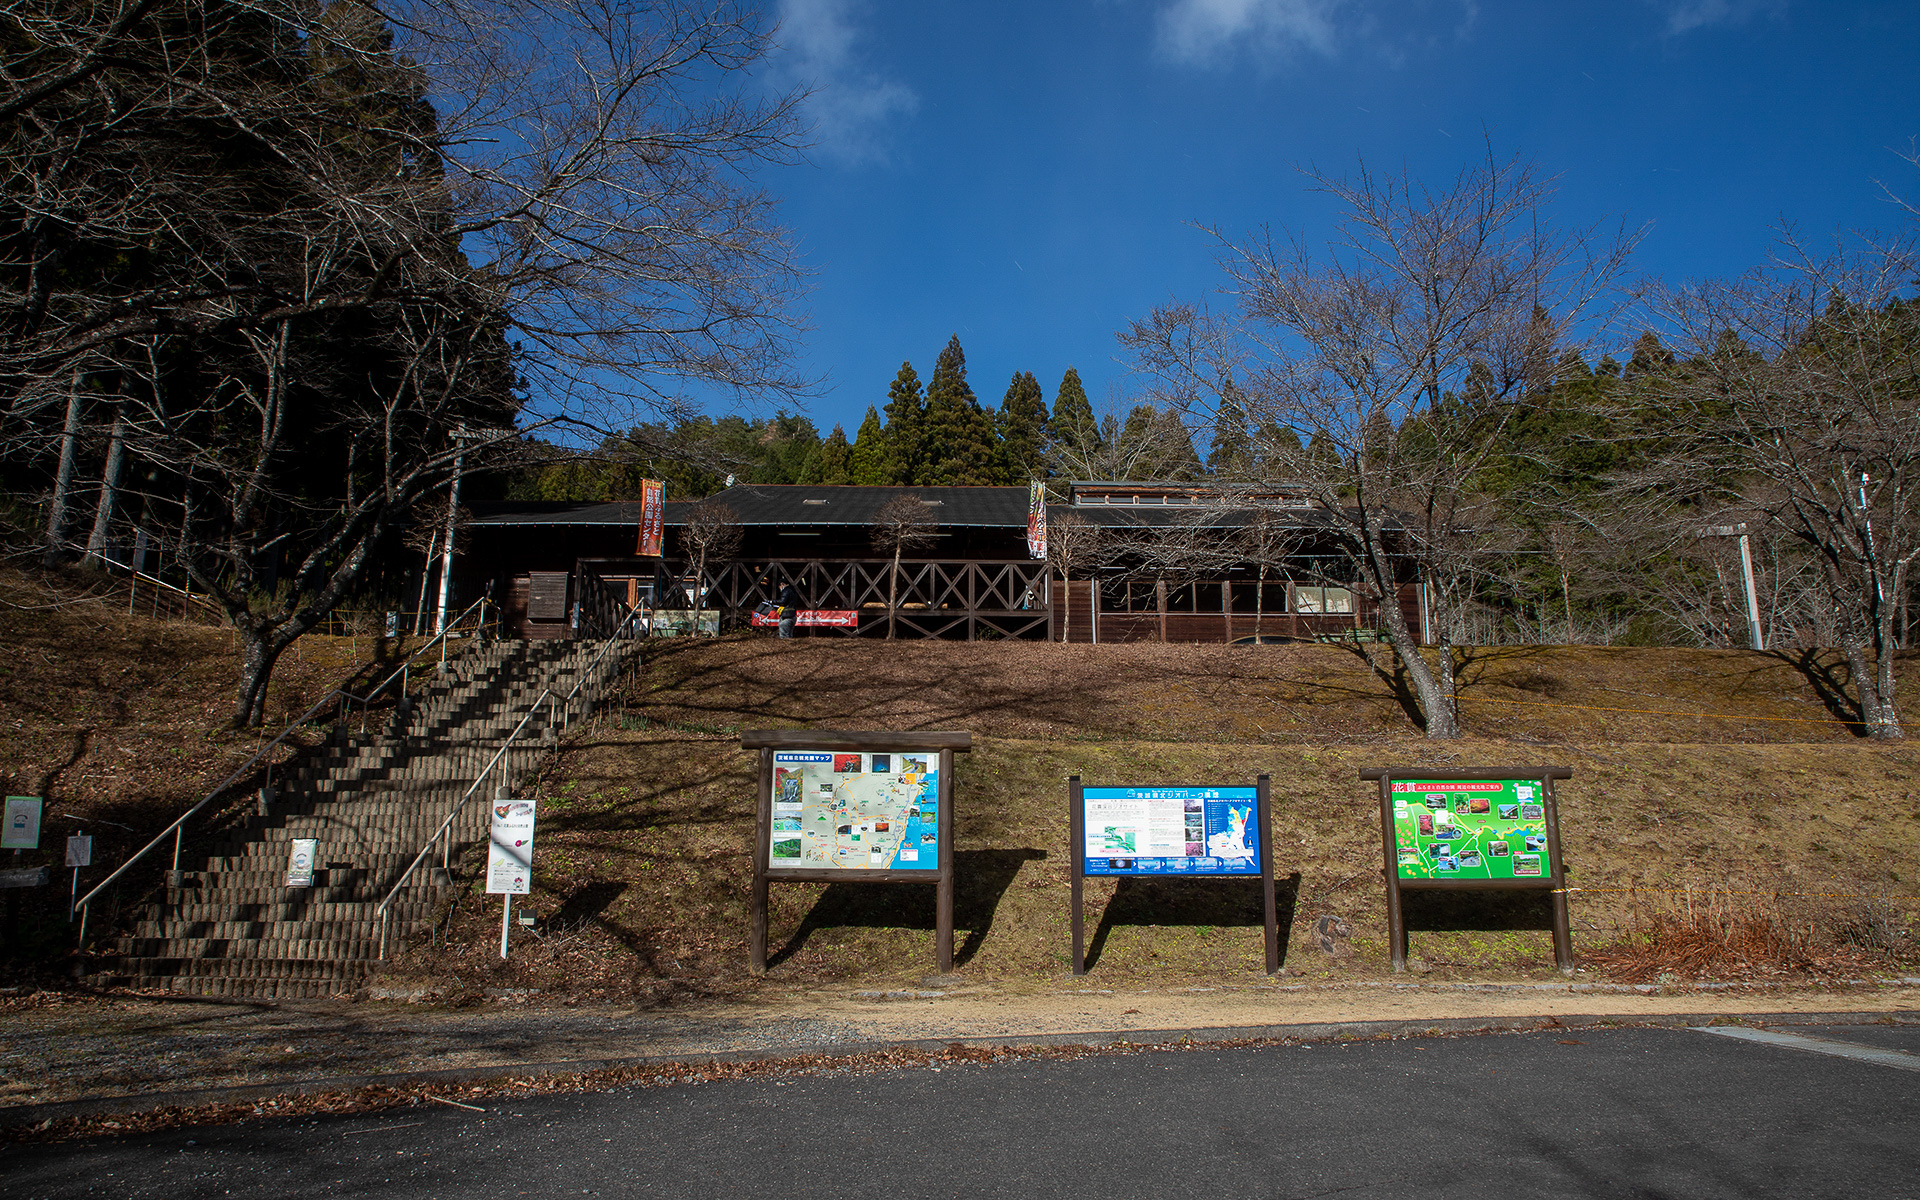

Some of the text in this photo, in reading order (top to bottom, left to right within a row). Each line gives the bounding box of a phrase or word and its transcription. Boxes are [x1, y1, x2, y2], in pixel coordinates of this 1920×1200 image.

[642, 487, 655, 547] 自然公園センター
[652, 489, 662, 536] 花貫ふるさと
